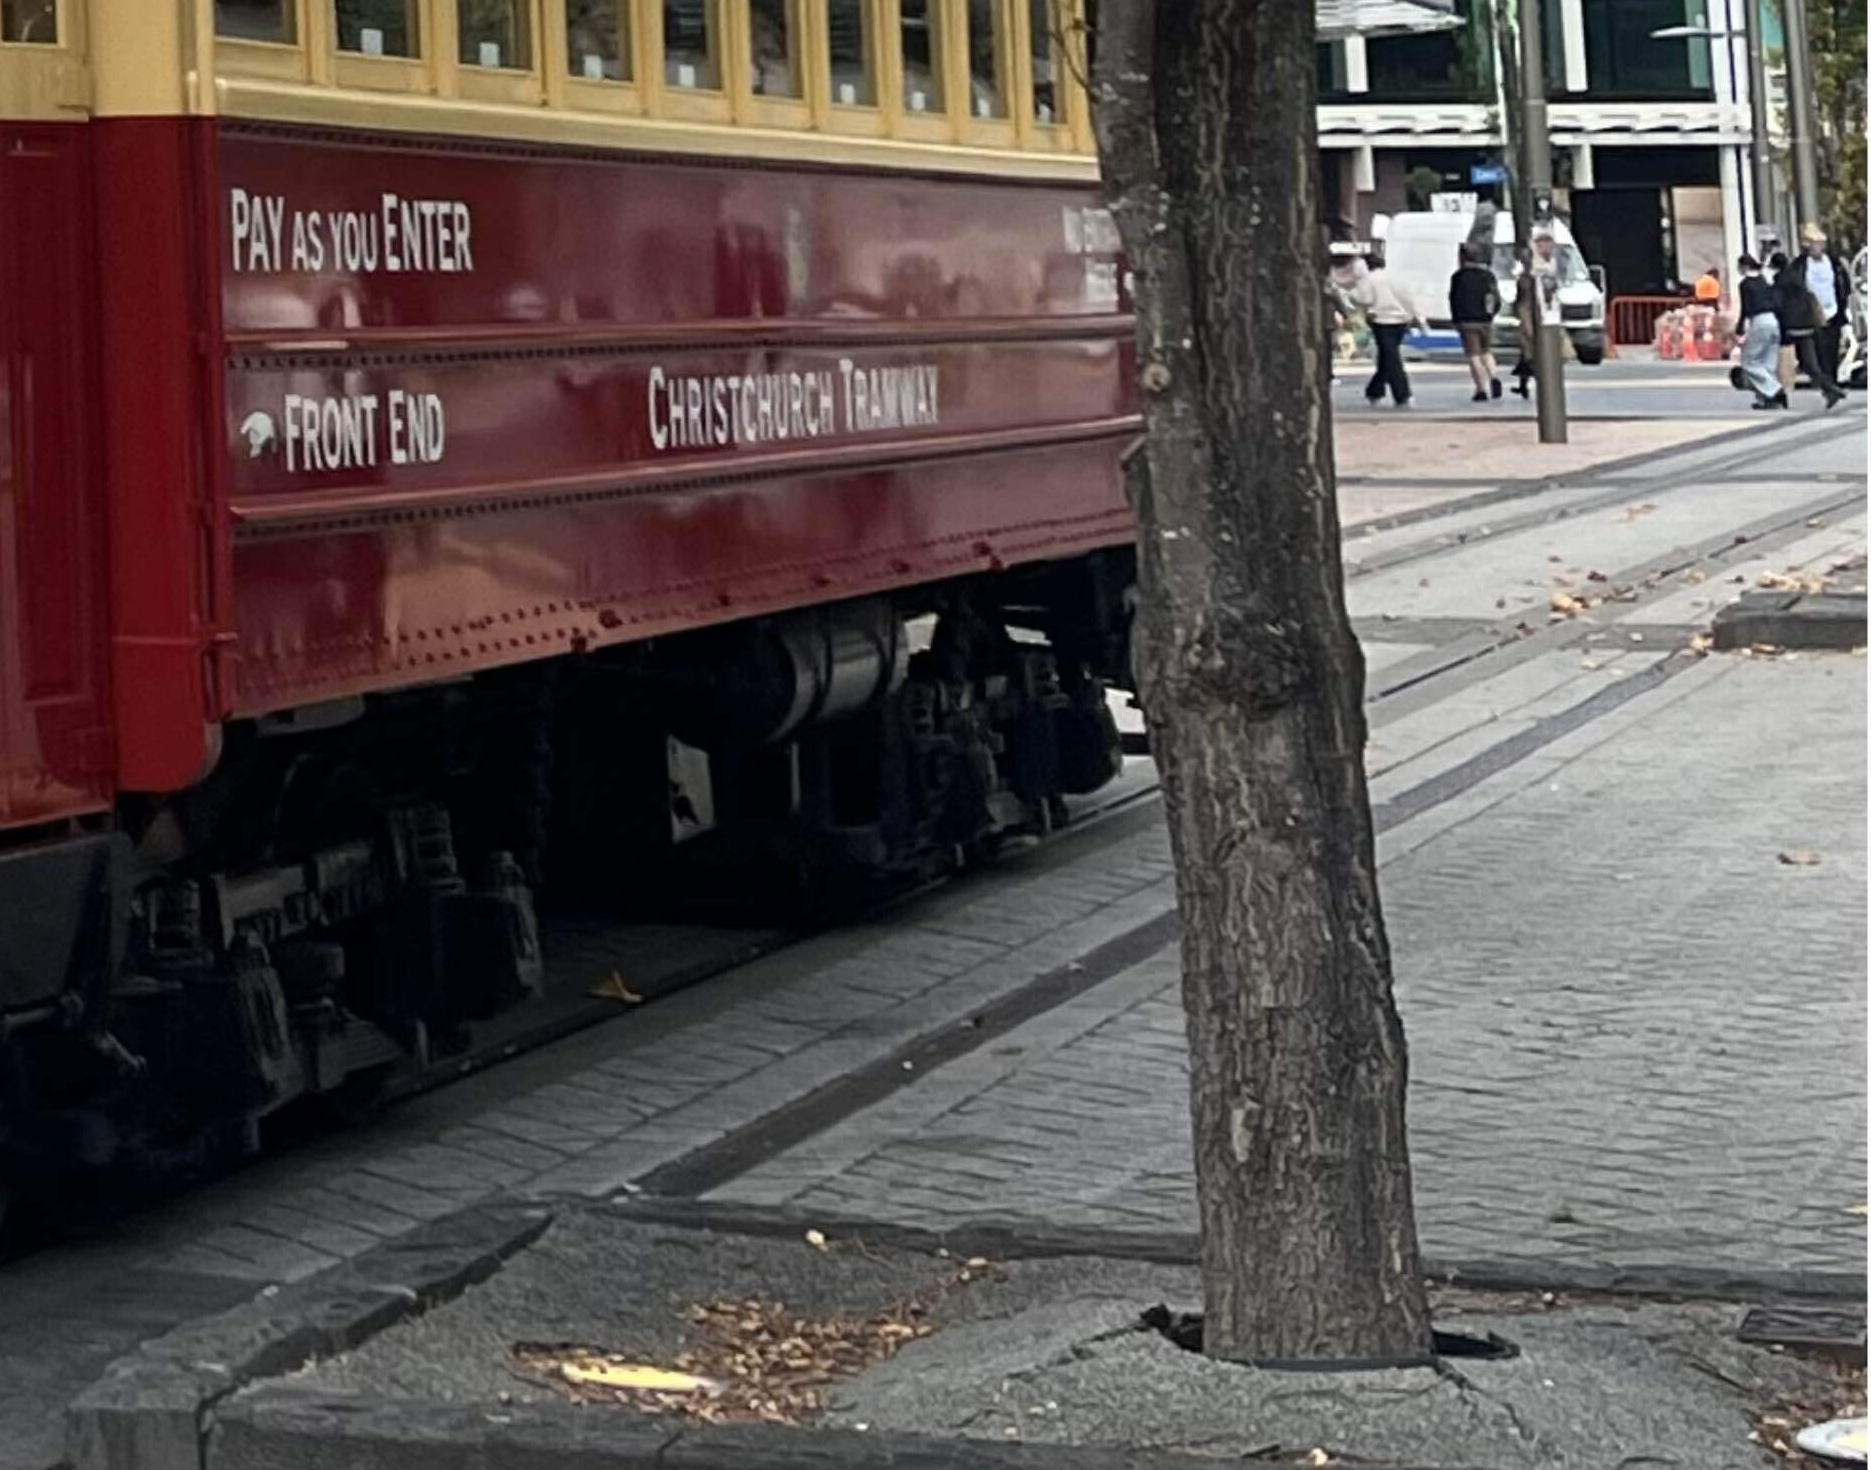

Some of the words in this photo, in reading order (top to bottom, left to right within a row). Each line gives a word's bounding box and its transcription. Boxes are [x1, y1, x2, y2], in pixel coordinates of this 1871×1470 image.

[231, 188, 284, 271] PAY
[292, 211, 324, 272] AS
[328, 212, 378, 272] YOU
[383, 193, 473, 272] ENTER
[284, 394, 378, 472] FRONT
[389, 390, 444, 464] END
[648, 366, 834, 450] CHRISTCHURCH
[839, 358, 938, 431] TRAMWAY
